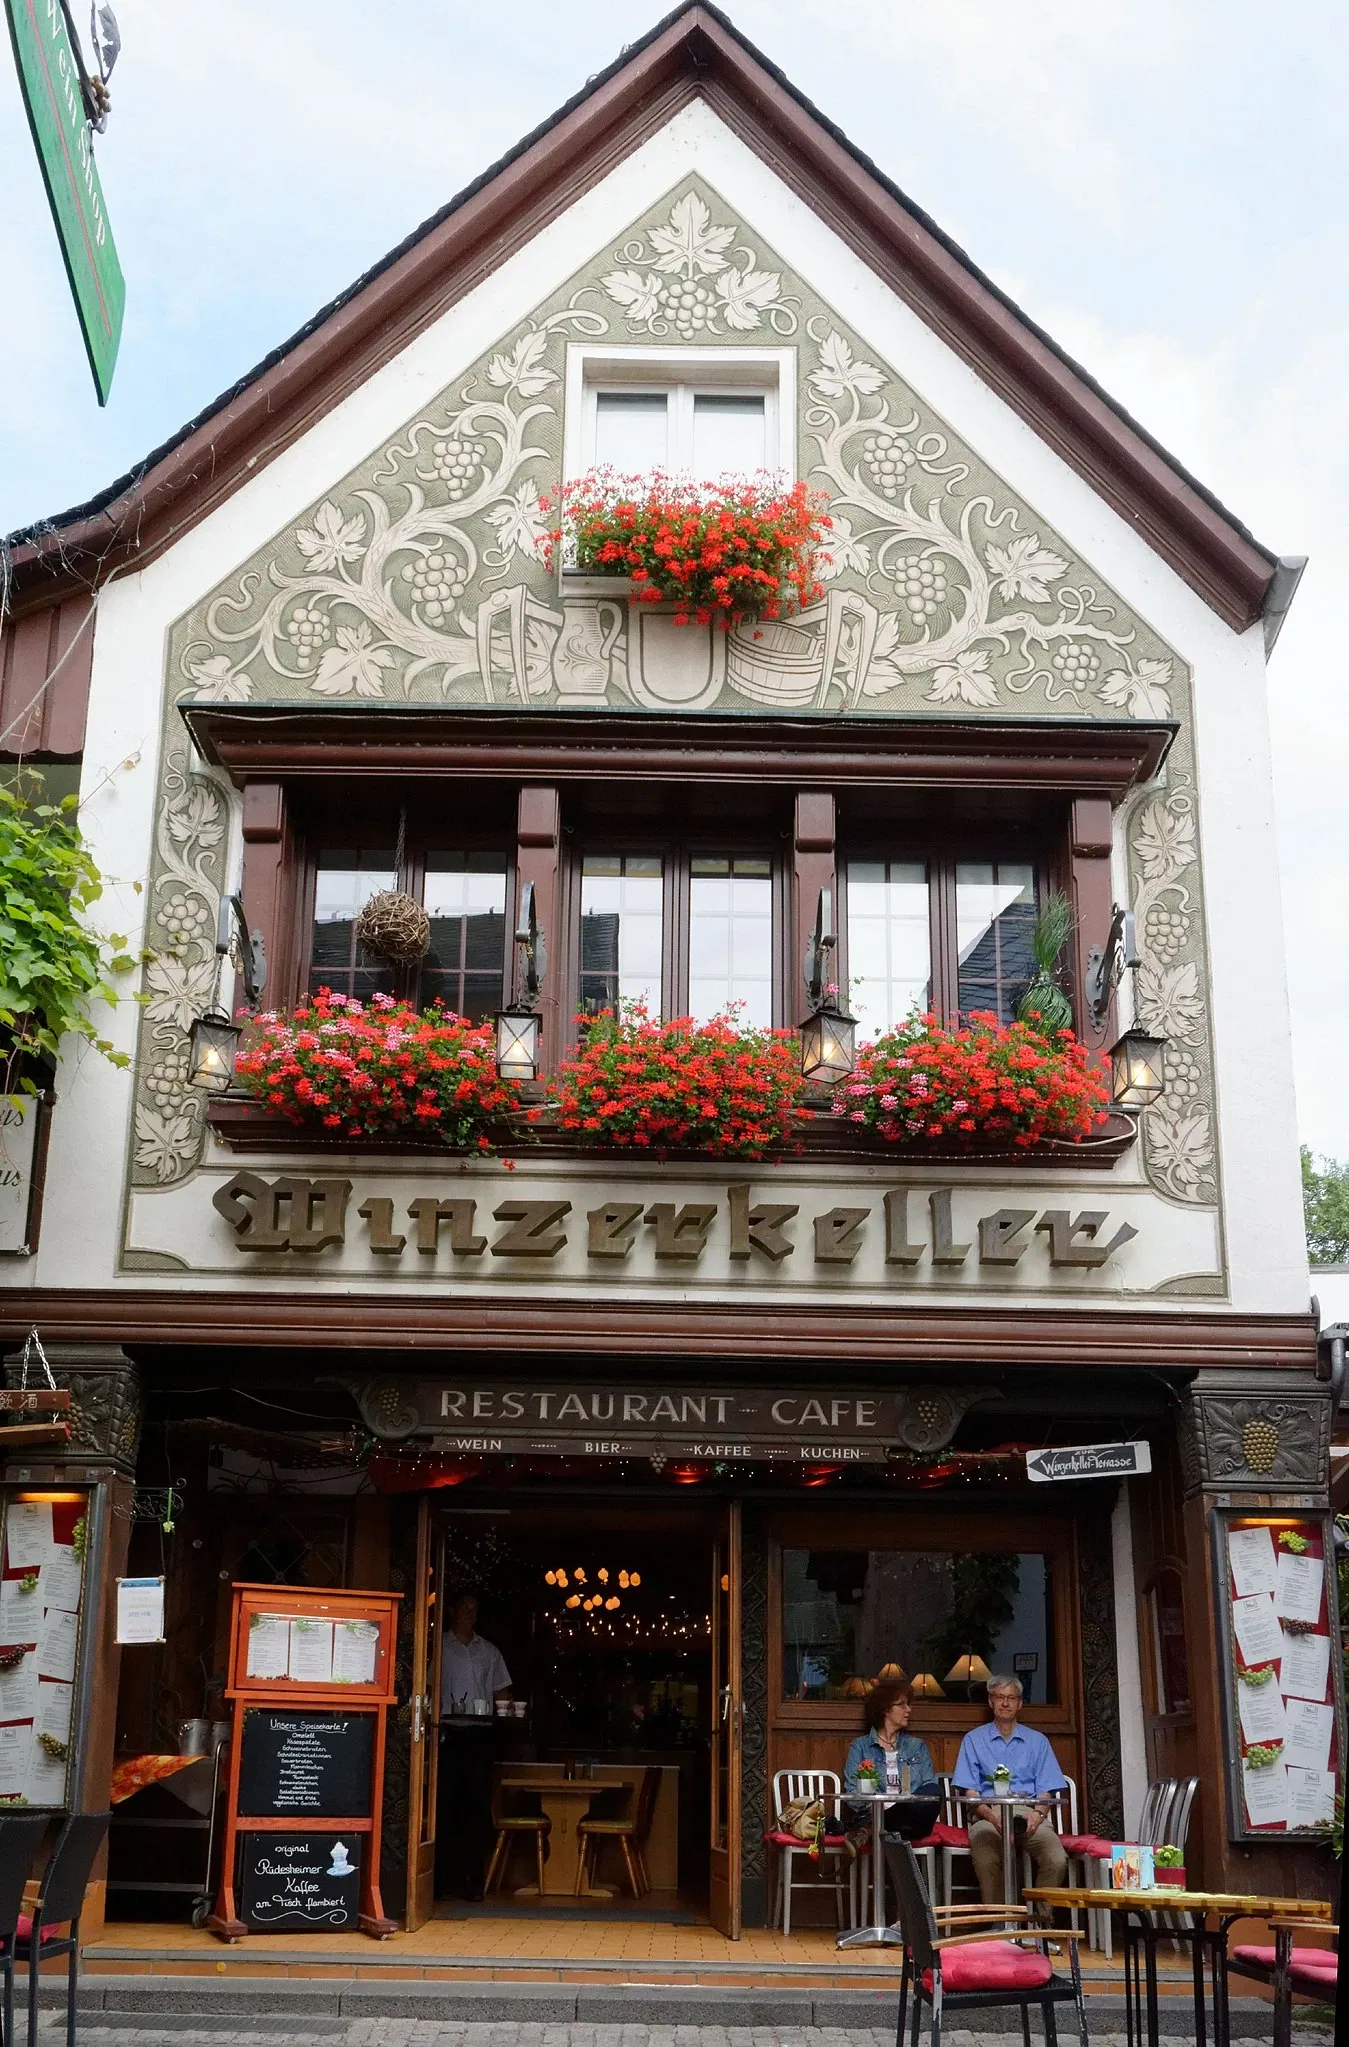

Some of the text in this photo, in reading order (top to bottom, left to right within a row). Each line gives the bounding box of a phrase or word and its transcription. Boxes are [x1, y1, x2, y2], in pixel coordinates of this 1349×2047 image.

[78, 125, 106, 247] Shop
[212, 1170, 1139, 1268] Winzerkeller
[441, 1390, 734, 1424] RESTAURANT
[457, 1439, 860, 1459] WEIN BIER KAFFEE KUCHEN
[270, 1719, 297, 1730] Unsere
[275, 1844, 309, 1857] original
[254, 1859, 323, 1875] Rüdesheimer
[284, 1877, 320, 1894] Kaffee
[256, 1895, 345, 1911] am Tisch flambiert
